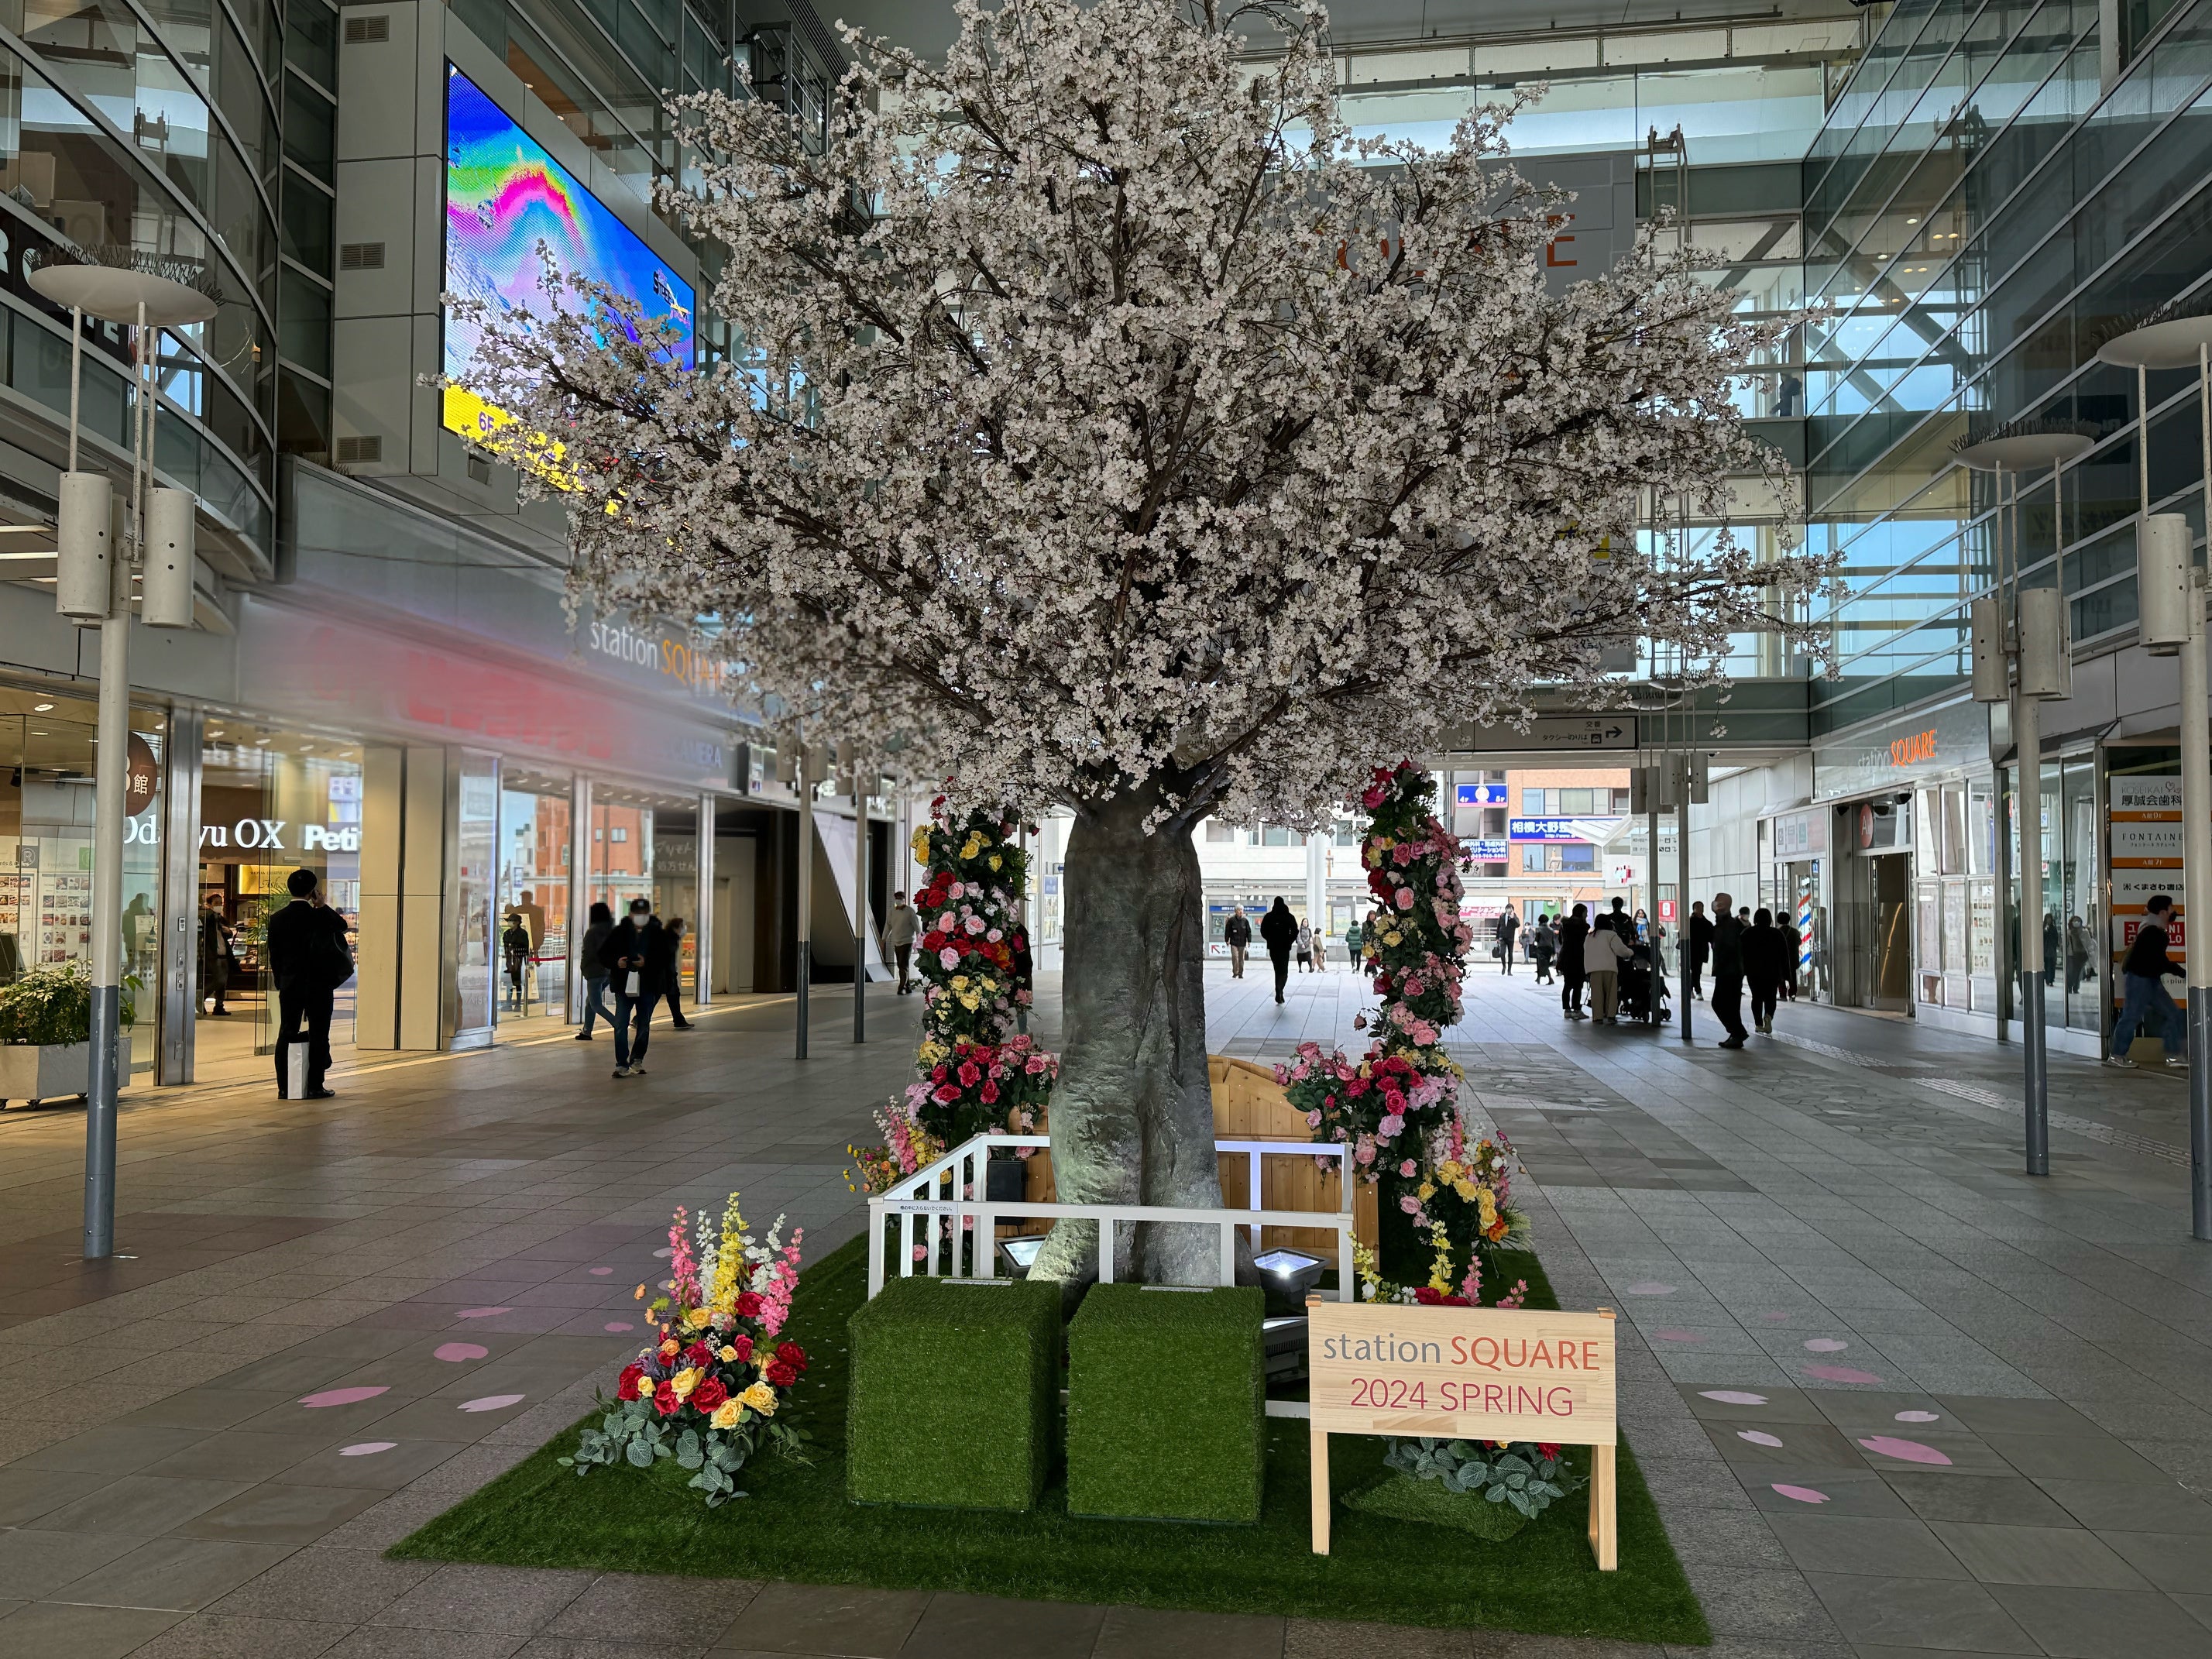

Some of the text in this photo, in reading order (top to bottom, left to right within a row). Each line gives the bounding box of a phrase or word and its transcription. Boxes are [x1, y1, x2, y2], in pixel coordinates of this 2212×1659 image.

[590, 622, 658, 669] station
[1858, 729, 1936, 775] station SQUARE
[2122, 795, 2183, 806] 厚誠会歯科
[235, 818, 286, 850] OX
[2123, 833, 2184, 841] FONTAINE
[1324, 1333, 1600, 1372] station SQUARE
[1351, 1378, 1574, 1417] 2024 SPRING
